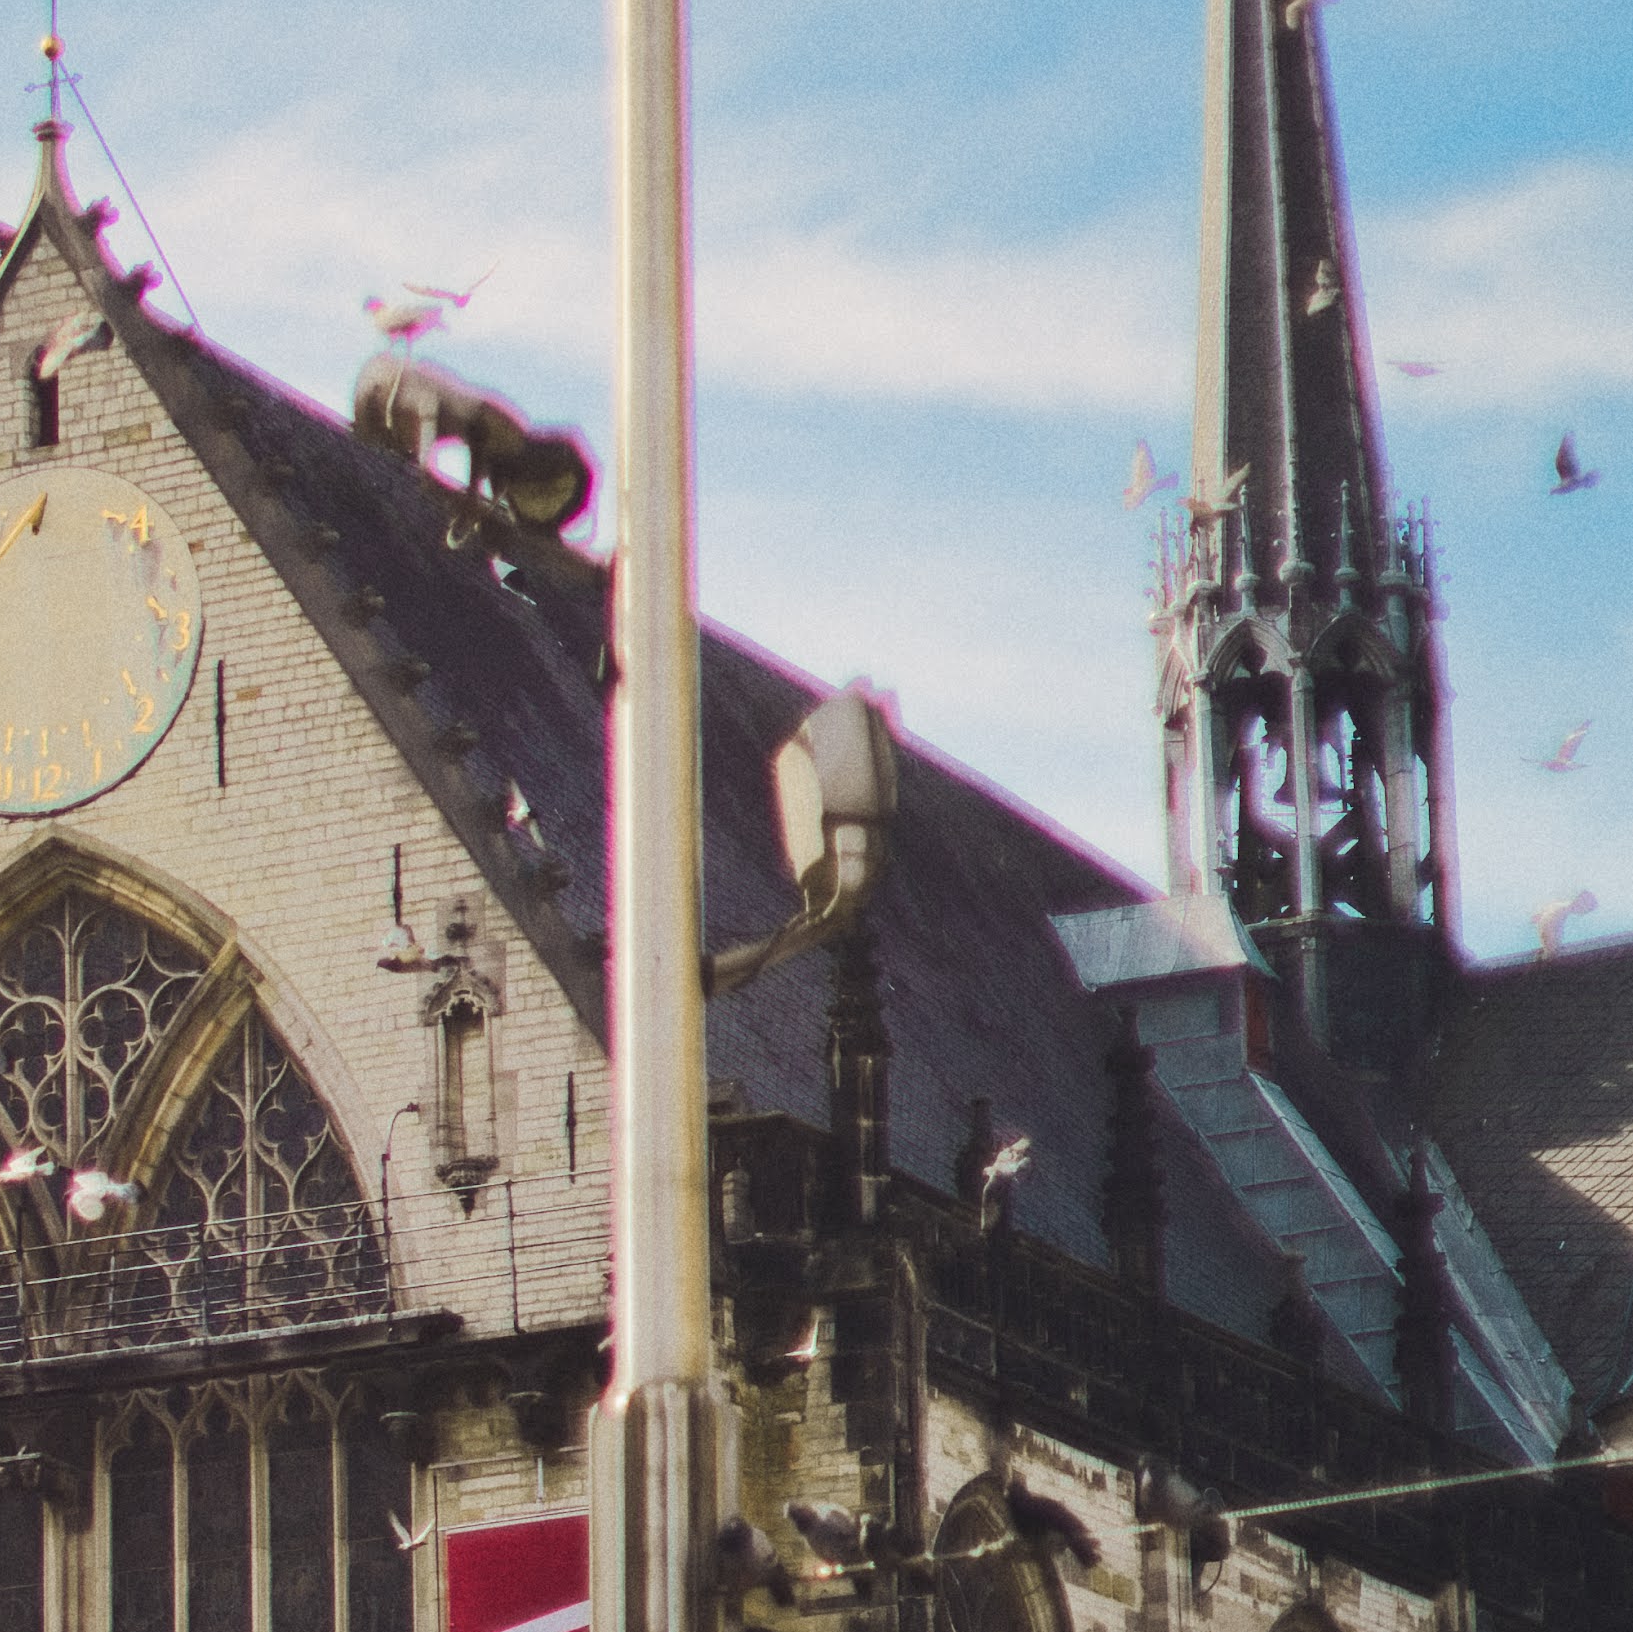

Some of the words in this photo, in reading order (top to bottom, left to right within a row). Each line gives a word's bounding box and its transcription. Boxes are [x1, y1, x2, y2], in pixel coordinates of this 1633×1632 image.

[130, 504, 154, 543] 4
[173, 610, 191, 651] 3
[132, 695, 155, 733] 2
[32, 763, 63, 802] 12
